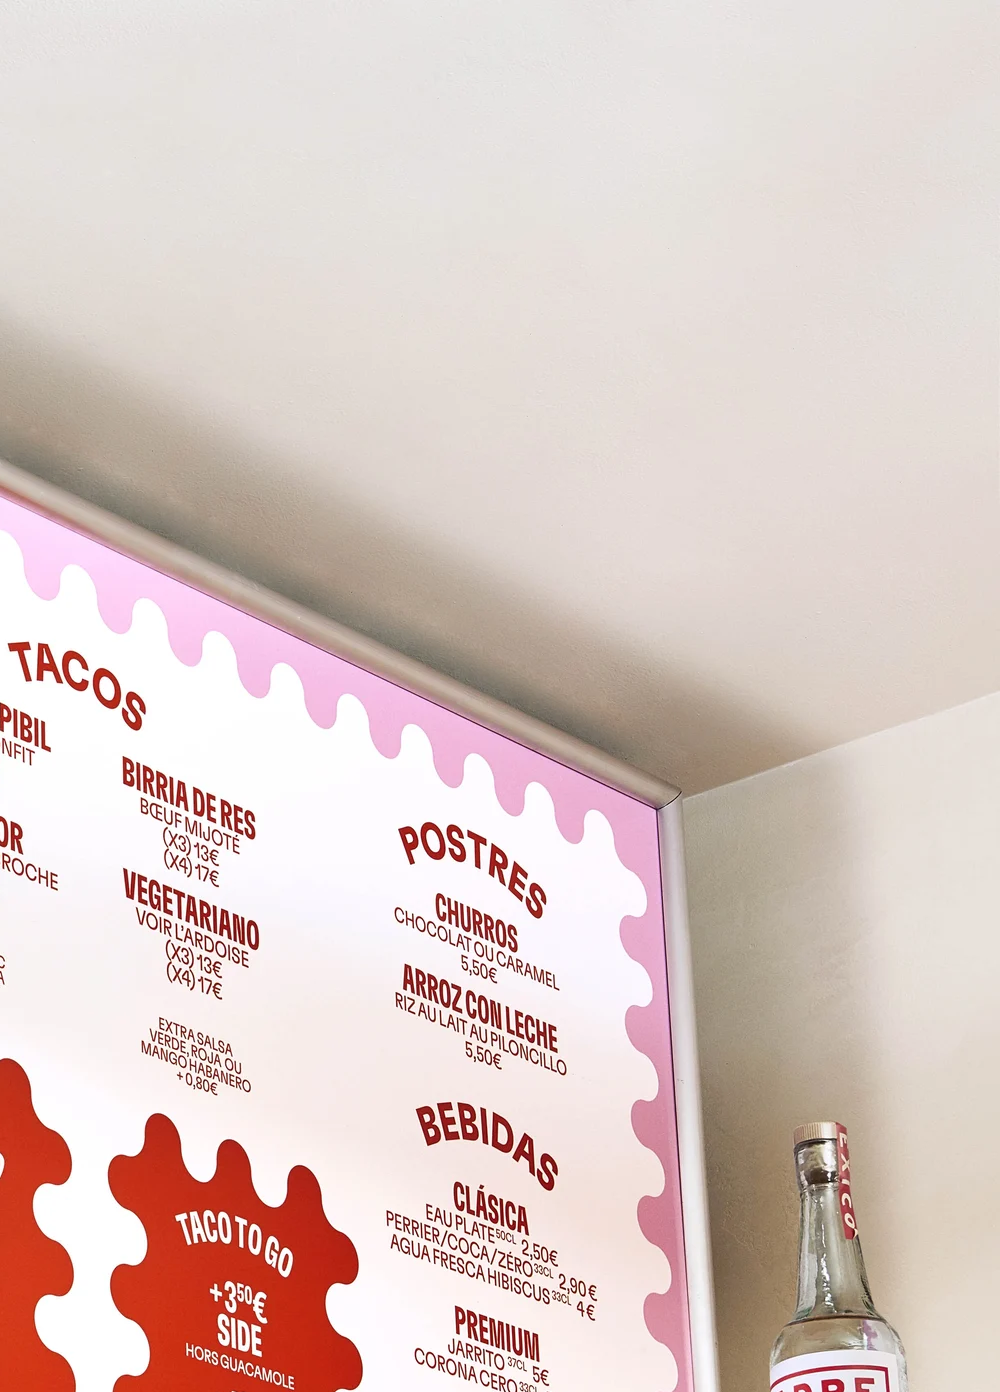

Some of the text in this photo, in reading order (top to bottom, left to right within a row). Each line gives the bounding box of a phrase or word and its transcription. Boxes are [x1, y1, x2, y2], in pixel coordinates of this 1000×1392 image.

[8, 641, 146, 731] TACOS
[0, 702, 51, 753] PIBIL
[122, 756, 256, 841] BIRRIA DE RES
[140, 797, 241, 855] BŒUF MIJOTÉ
[398, 822, 546, 919] POSTRES
[123, 867, 260, 951] VEGETARIANO
[136, 907, 171, 938] VOIR
[435, 893, 518, 952] CHURROS
[394, 907, 559, 991] CHOCOLAT OU CARAMEL
[461, 955, 497, 984] 5,50€
[403, 963, 558, 1053] ARROZ CON LECHE
[159, 1017, 233, 1057] EXTRA SALSA
[191, 1045, 222, 1067] ROJA
[225, 1057, 242, 1075] OU
[141, 1040, 251, 1093] MANGO HABANERO
[416, 1102, 558, 1191] BEBIDAS
[453, 1181, 529, 1236] CLÁSICA
[175, 1210, 293, 1278] TACO TO GO
[391, 1234, 430, 1263] AGUA
[433, 1248, 485, 1282] FRESCA
[488, 1268, 550, 1305] HIBISCUS
[218, 1313, 262, 1357] SIDE
[454, 1305, 540, 1362] PREMIUM
[186, 1343, 294, 1390] HORS GUACAMOLE
[448, 1338, 505, 1371] JARRITO
[533, 1366, 549, 1387] 5€
